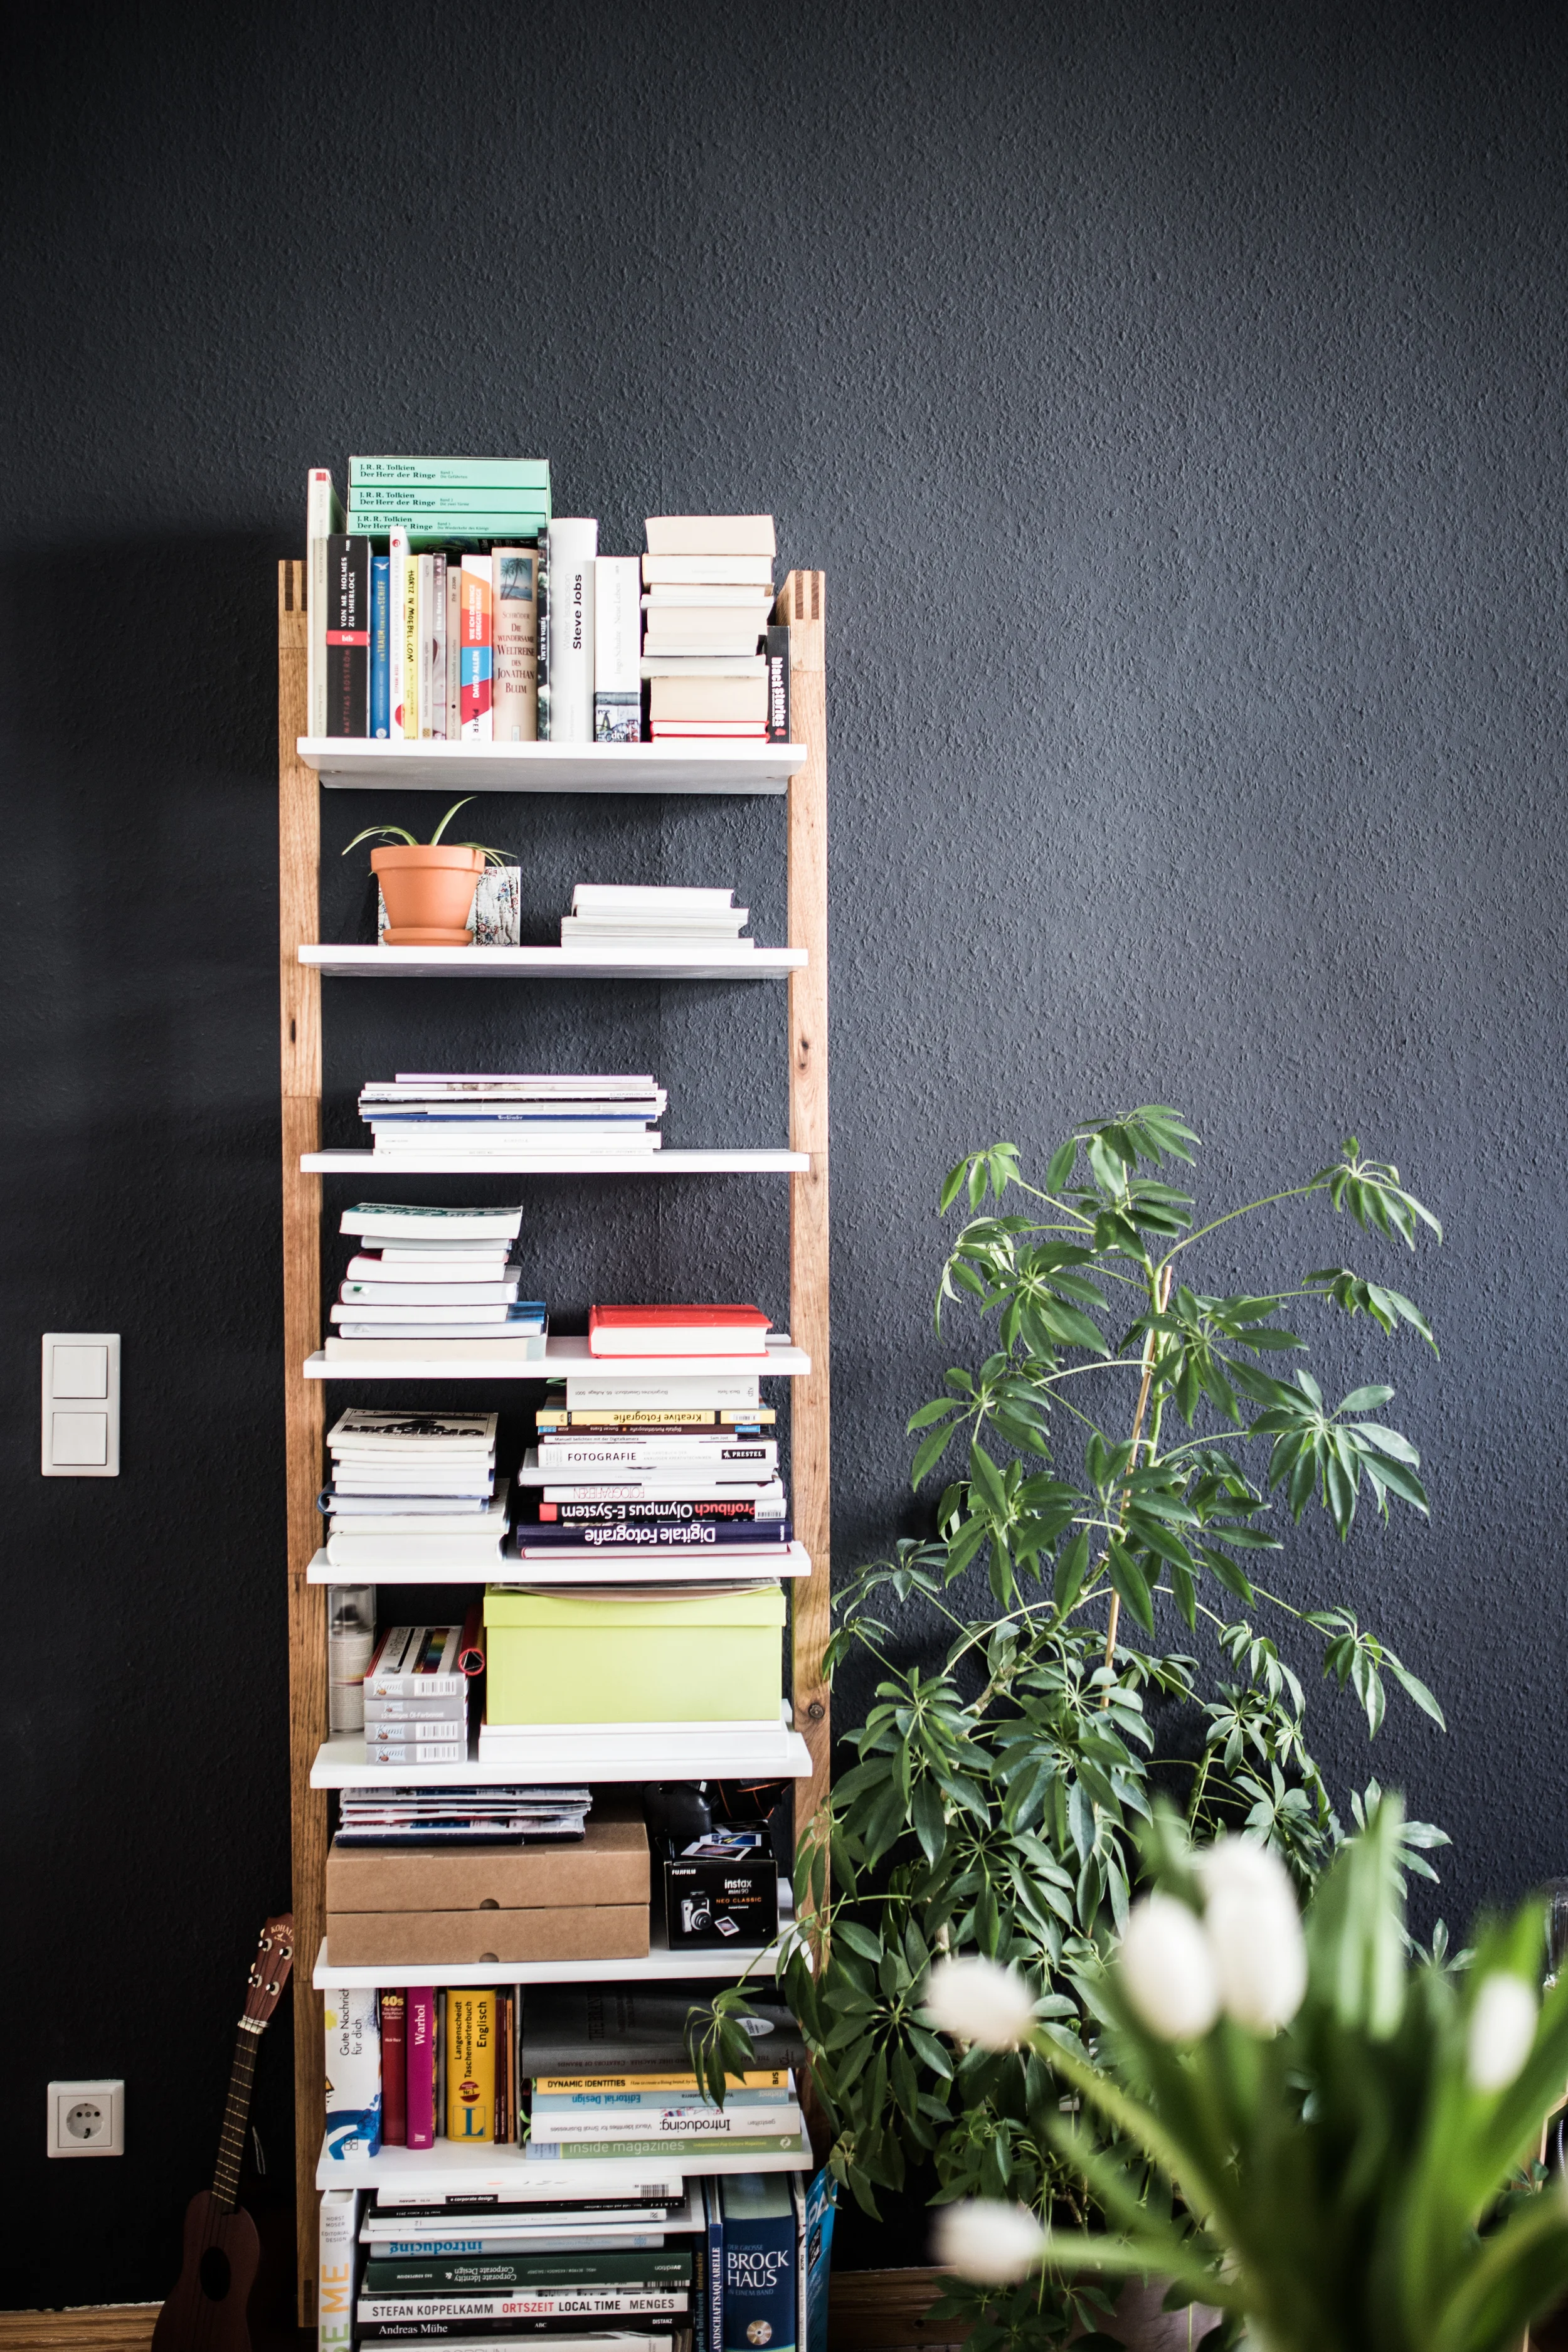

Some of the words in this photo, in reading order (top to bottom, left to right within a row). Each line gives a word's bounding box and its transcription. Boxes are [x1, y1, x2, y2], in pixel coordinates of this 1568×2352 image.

[413, 471, 436, 480] Ringe
[413, 499, 436, 507] Ringe
[410, 524, 433, 532] Ringe
[563, 573, 571, 618] Isaacson
[573, 574, 582, 607] Jobs
[348, 616, 355, 628] ZU
[573, 610, 582, 650] Steve
[377, 630, 385, 653] TRAUM
[497, 635, 534, 643] WUNDERSAME
[613, 659, 623, 675] Ingo
[771, 657, 783, 687] black
[775, 687, 786, 726] stories
[613, 1411, 661, 1423] Fotografie
[664, 1414, 701, 1422] Kreative
[568, 1452, 637, 1461] FOTOGRAFIE
[573, 1487, 645, 1499] FOTOGRAFIEREN
[561, 1503, 626, 1519] E-System
[629, 1502, 693, 1518] Olympus
[695, 1503, 755, 1517] Profibuch
[585, 1525, 657, 1545] Fotografie
[660, 1523, 716, 1544] Digitale
[724, 1878, 752, 1889] instax
[382, 1995, 404, 2006] 40s
[351, 2018, 362, 2039] dich
[414, 2004, 426, 2045] Warhol
[453, 2001, 464, 2060] Langenscheidt
[476, 2001, 489, 2048] Englisch
[339, 2032, 349, 2056] Gute
[351, 2042, 362, 2055] für
[594, 2060, 625, 2068] CREATORS
[585, 2079, 626, 2087] IDENTITIES
[572, 2094, 601, 2105] Design
[605, 2094, 641, 2104] Editorial
[659, 2118, 731, 2132] Introducing:
[569, 2140, 609, 2153] inside
[613, 2140, 685, 2155] magazines
[389, 2241, 483, 2255] introducing
[727, 2249, 790, 2270] BROCK
[445, 2272, 453, 2280] &
[453, 2266, 478, 2275] Design
[480, 2265, 514, 2275] Corporate
[482, 2272, 517, 2281] Corporate
[453, 2274, 481, 2282] Identity
[728, 2269, 778, 2287] HAUS
[320, 2262, 349, 2313] ME
[712, 2247, 723, 2352] ANDSCHAFTSAQUARELLE
[372, 2305, 413, 2317] STEFAN
[416, 2304, 494, 2316] KOPPELKAMM
[502, 2302, 554, 2313] ORTSZEIT
[558, 2301, 592, 2312] LOCAL
[595, 2300, 621, 2311] TIME
[629, 2299, 674, 2309] MENGES
[696, 2292, 704, 2330] Tafelwerk
[379, 2324, 418, 2334] Andreas
[420, 2323, 448, 2333] Mühe
